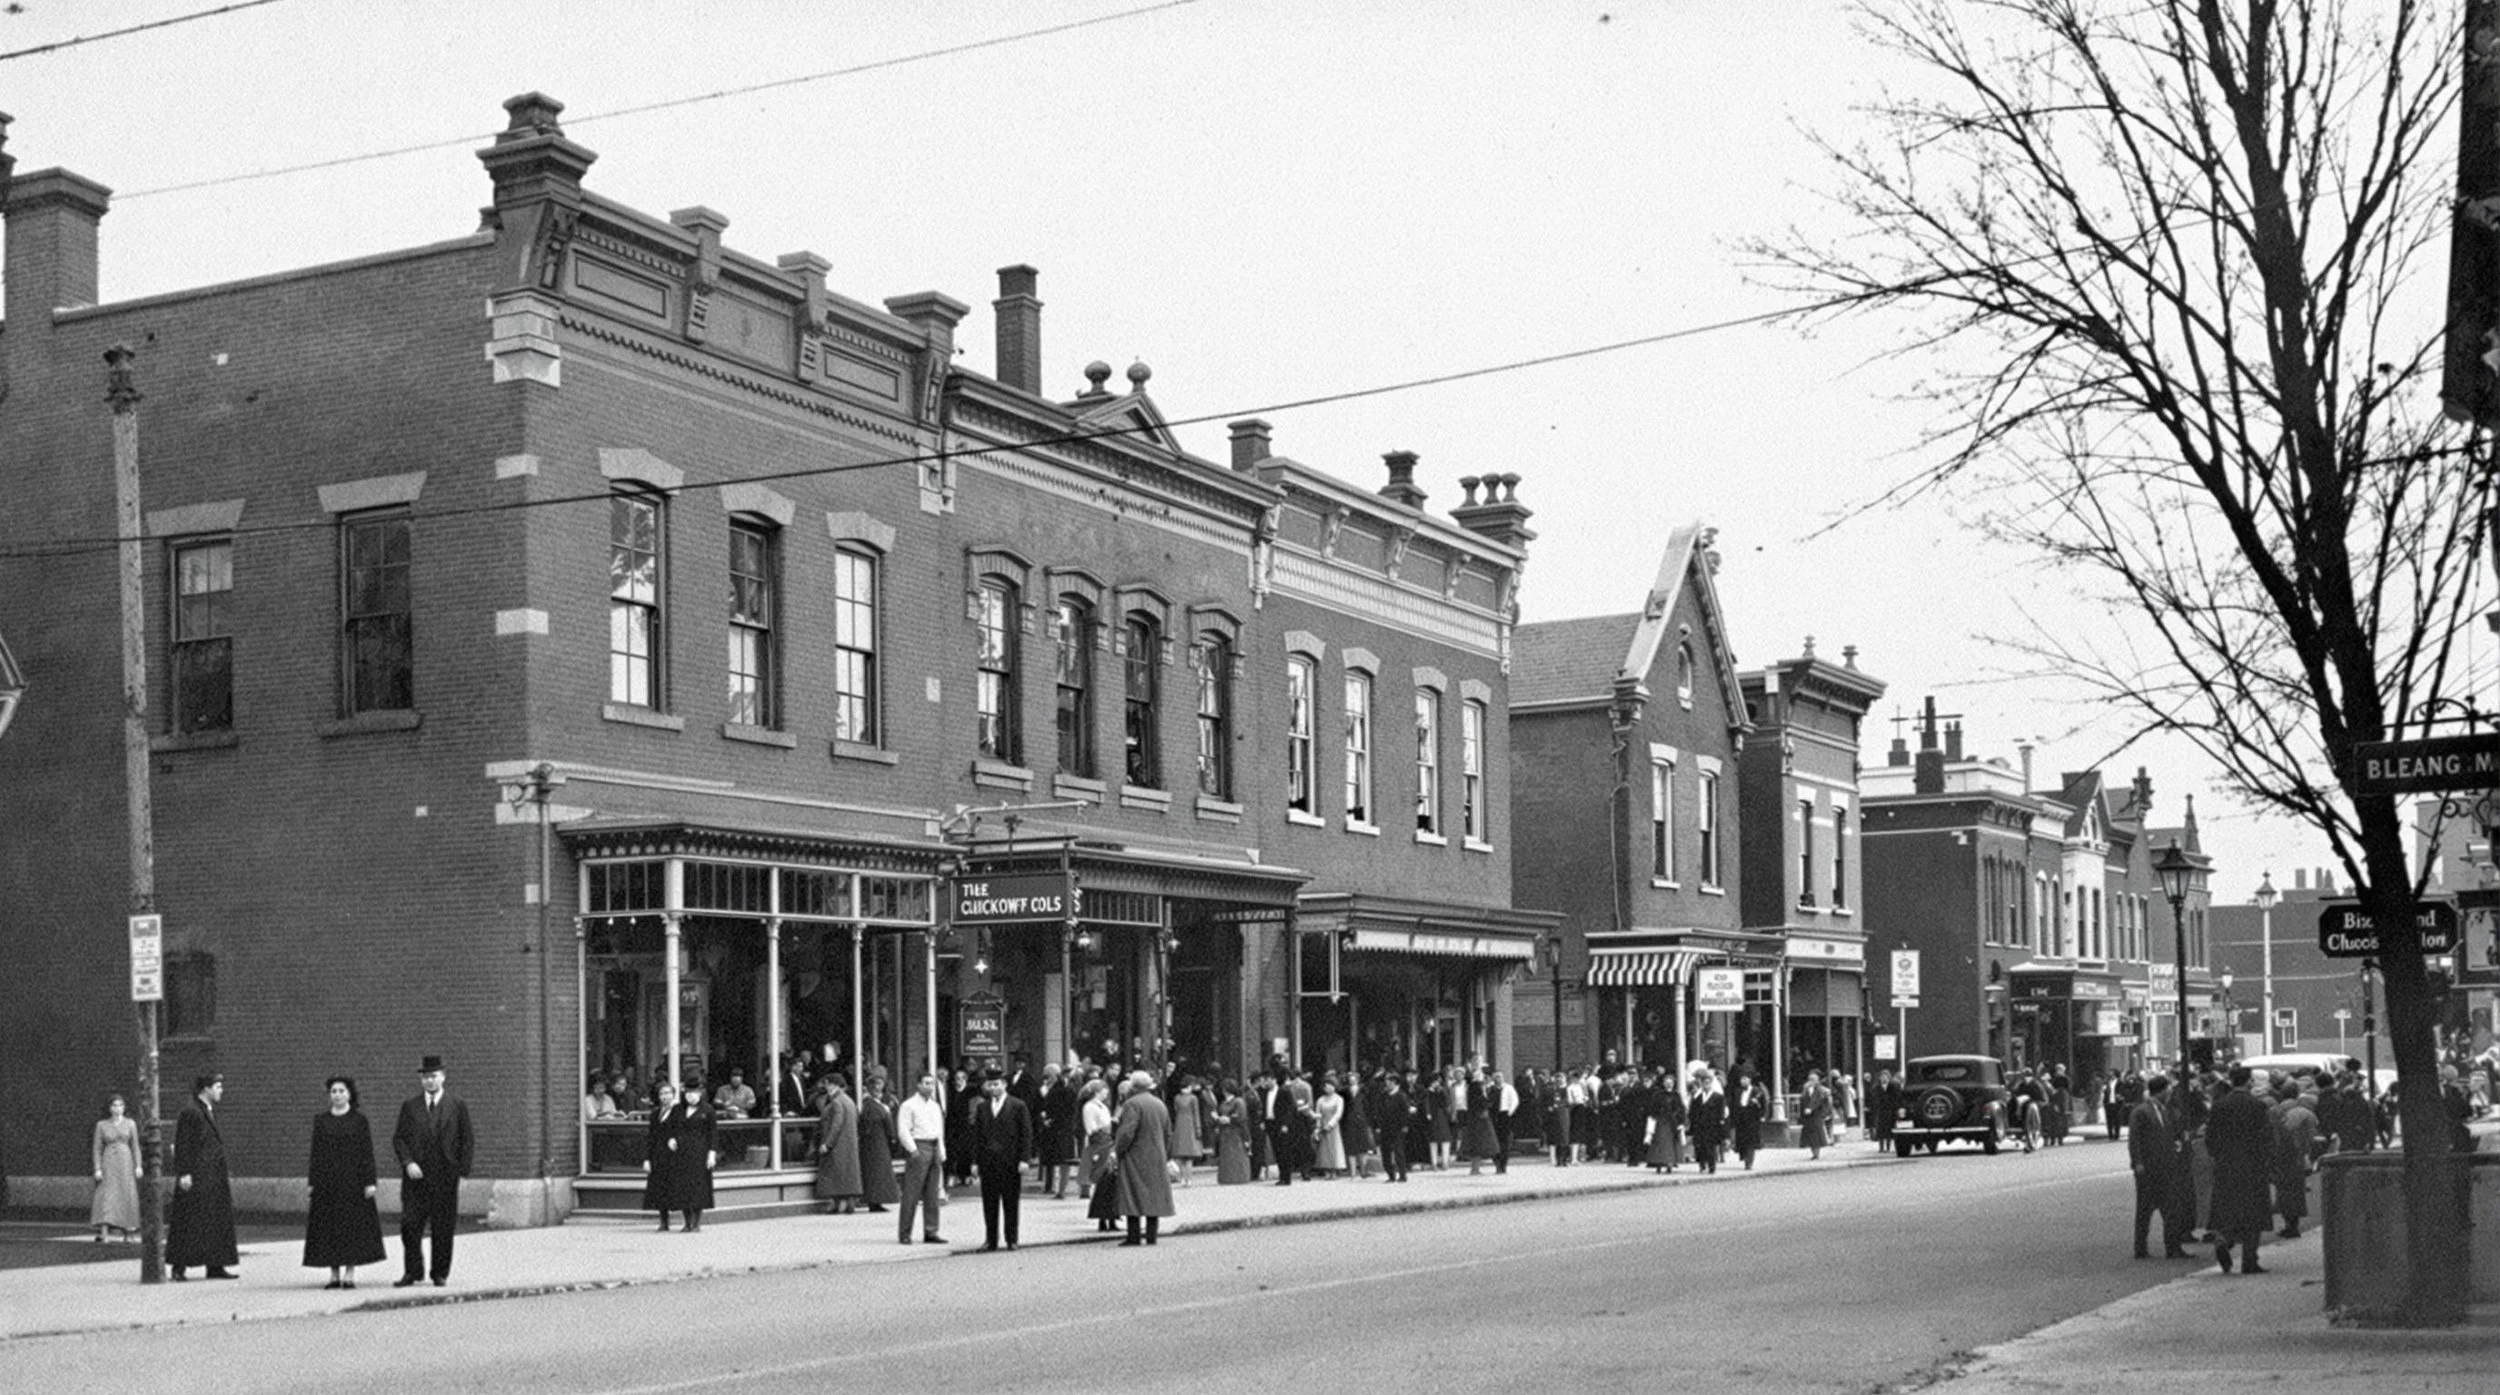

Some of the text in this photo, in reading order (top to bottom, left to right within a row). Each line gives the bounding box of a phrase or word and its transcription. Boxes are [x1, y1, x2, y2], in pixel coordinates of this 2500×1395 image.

[2367, 752, 2499, 779] BLEANG M
[2343, 908, 2437, 929] Biz nd
